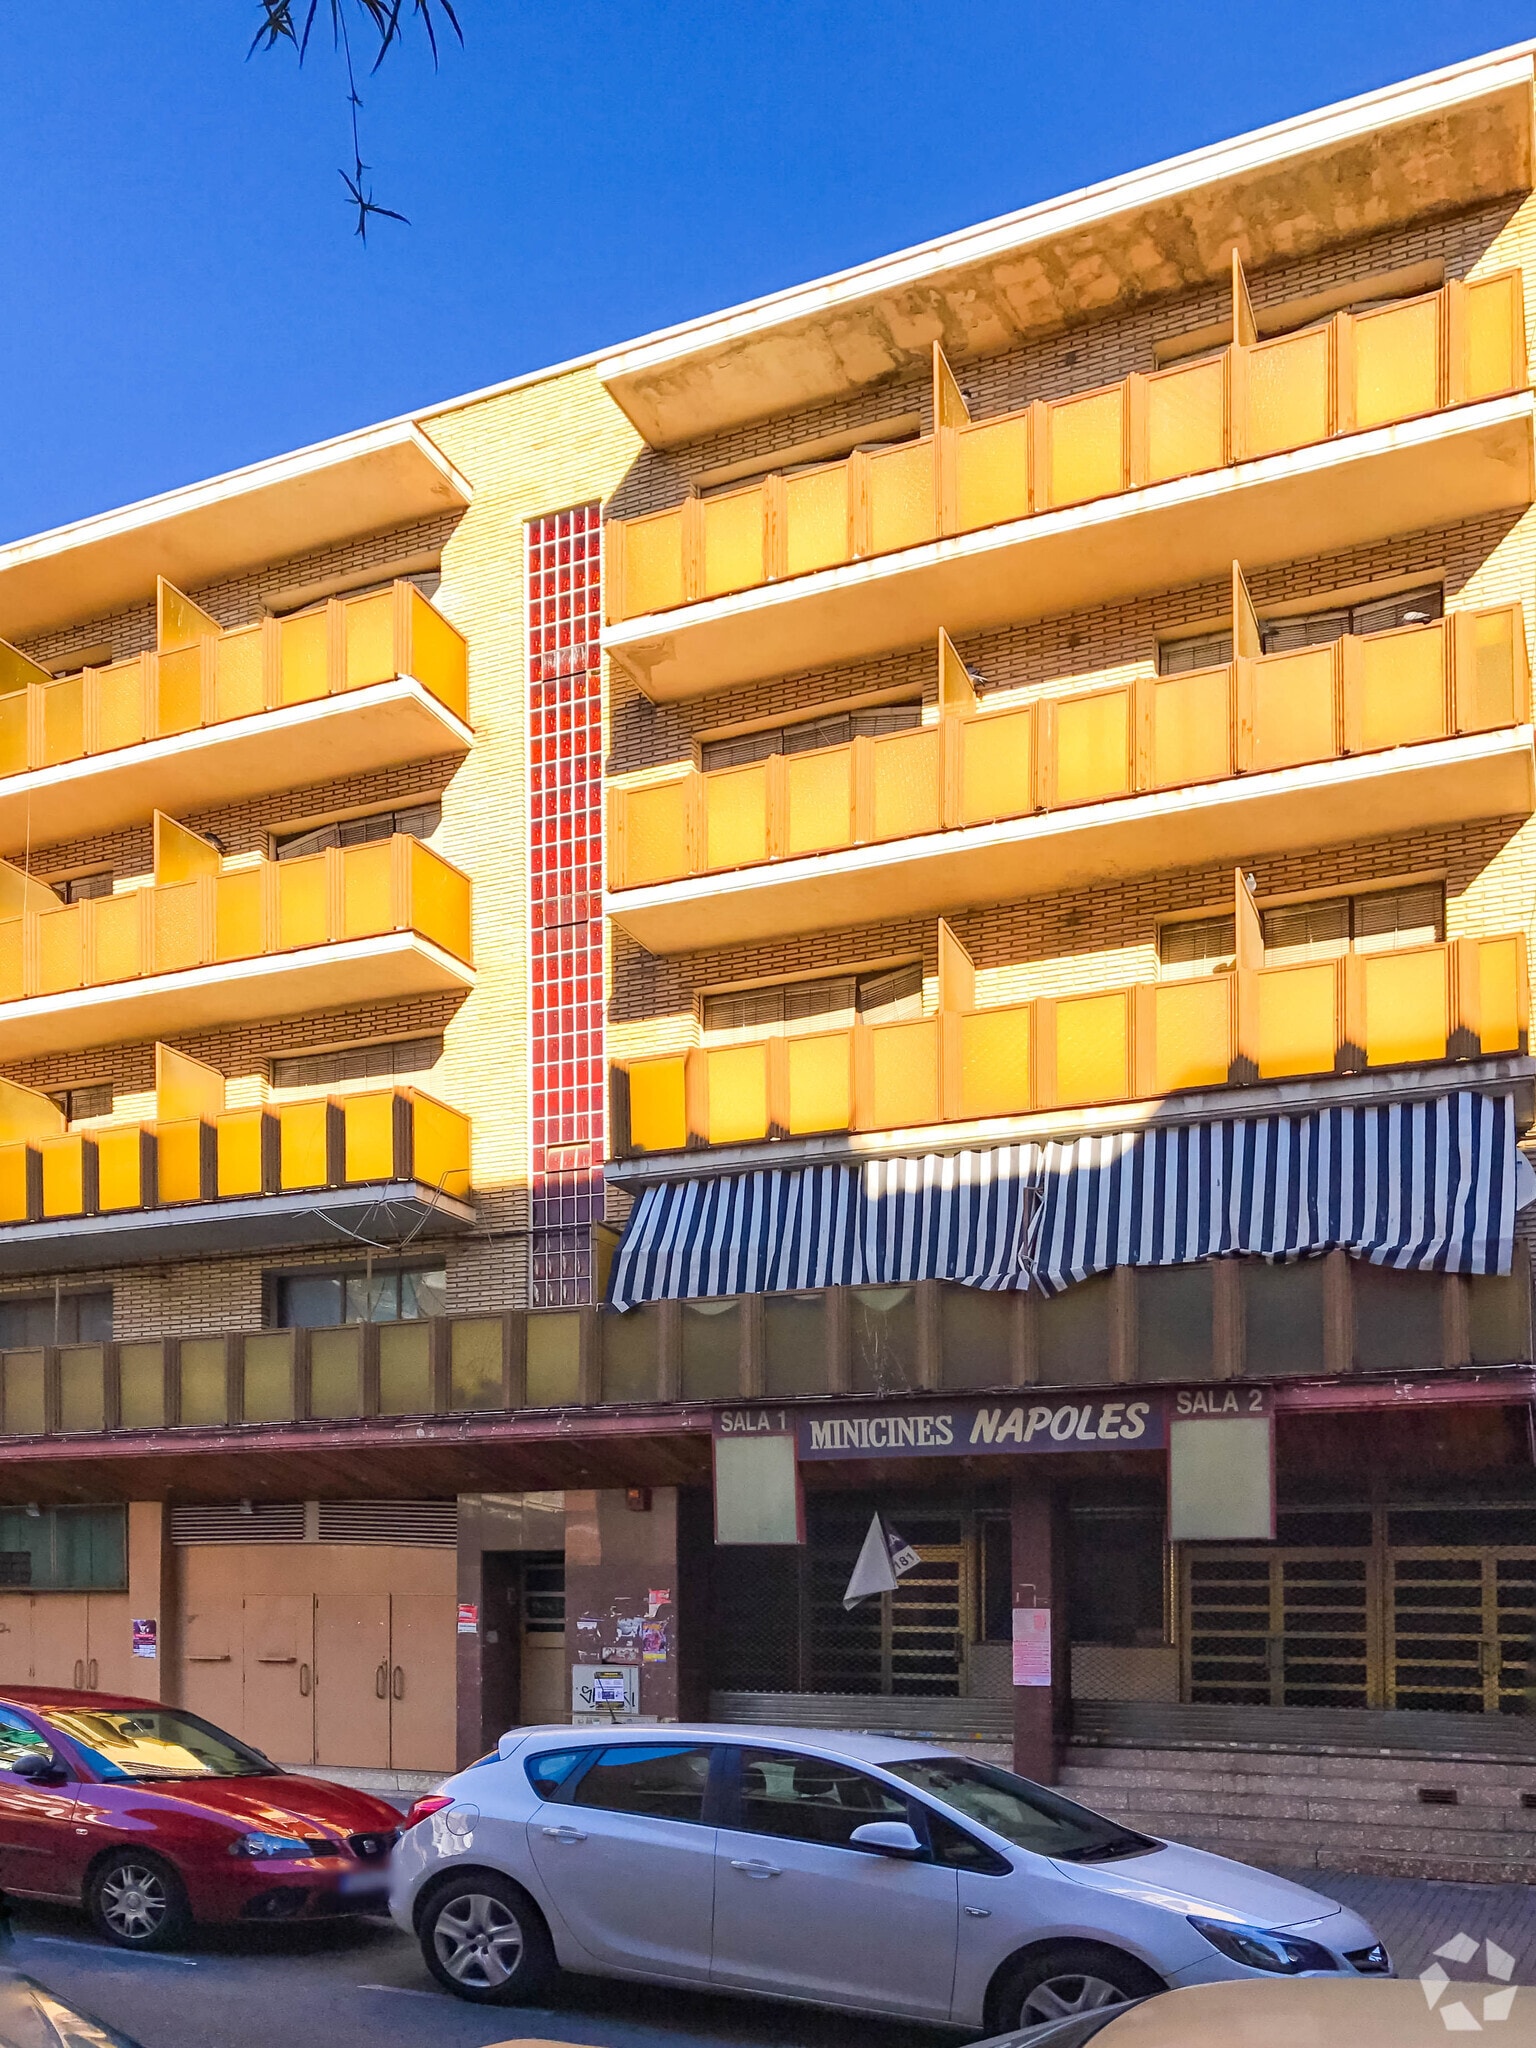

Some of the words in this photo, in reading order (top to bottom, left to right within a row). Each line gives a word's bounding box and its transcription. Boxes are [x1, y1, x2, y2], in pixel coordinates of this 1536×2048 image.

[1176, 1390, 1240, 1415] SALA
[1248, 1389, 1264, 1412] 2
[720, 1411, 771, 1433] SALA
[777, 1410, 787, 1431] 1
[809, 1415, 954, 1450] MINICINES
[969, 1402, 1150, 1445] NAPOLES
